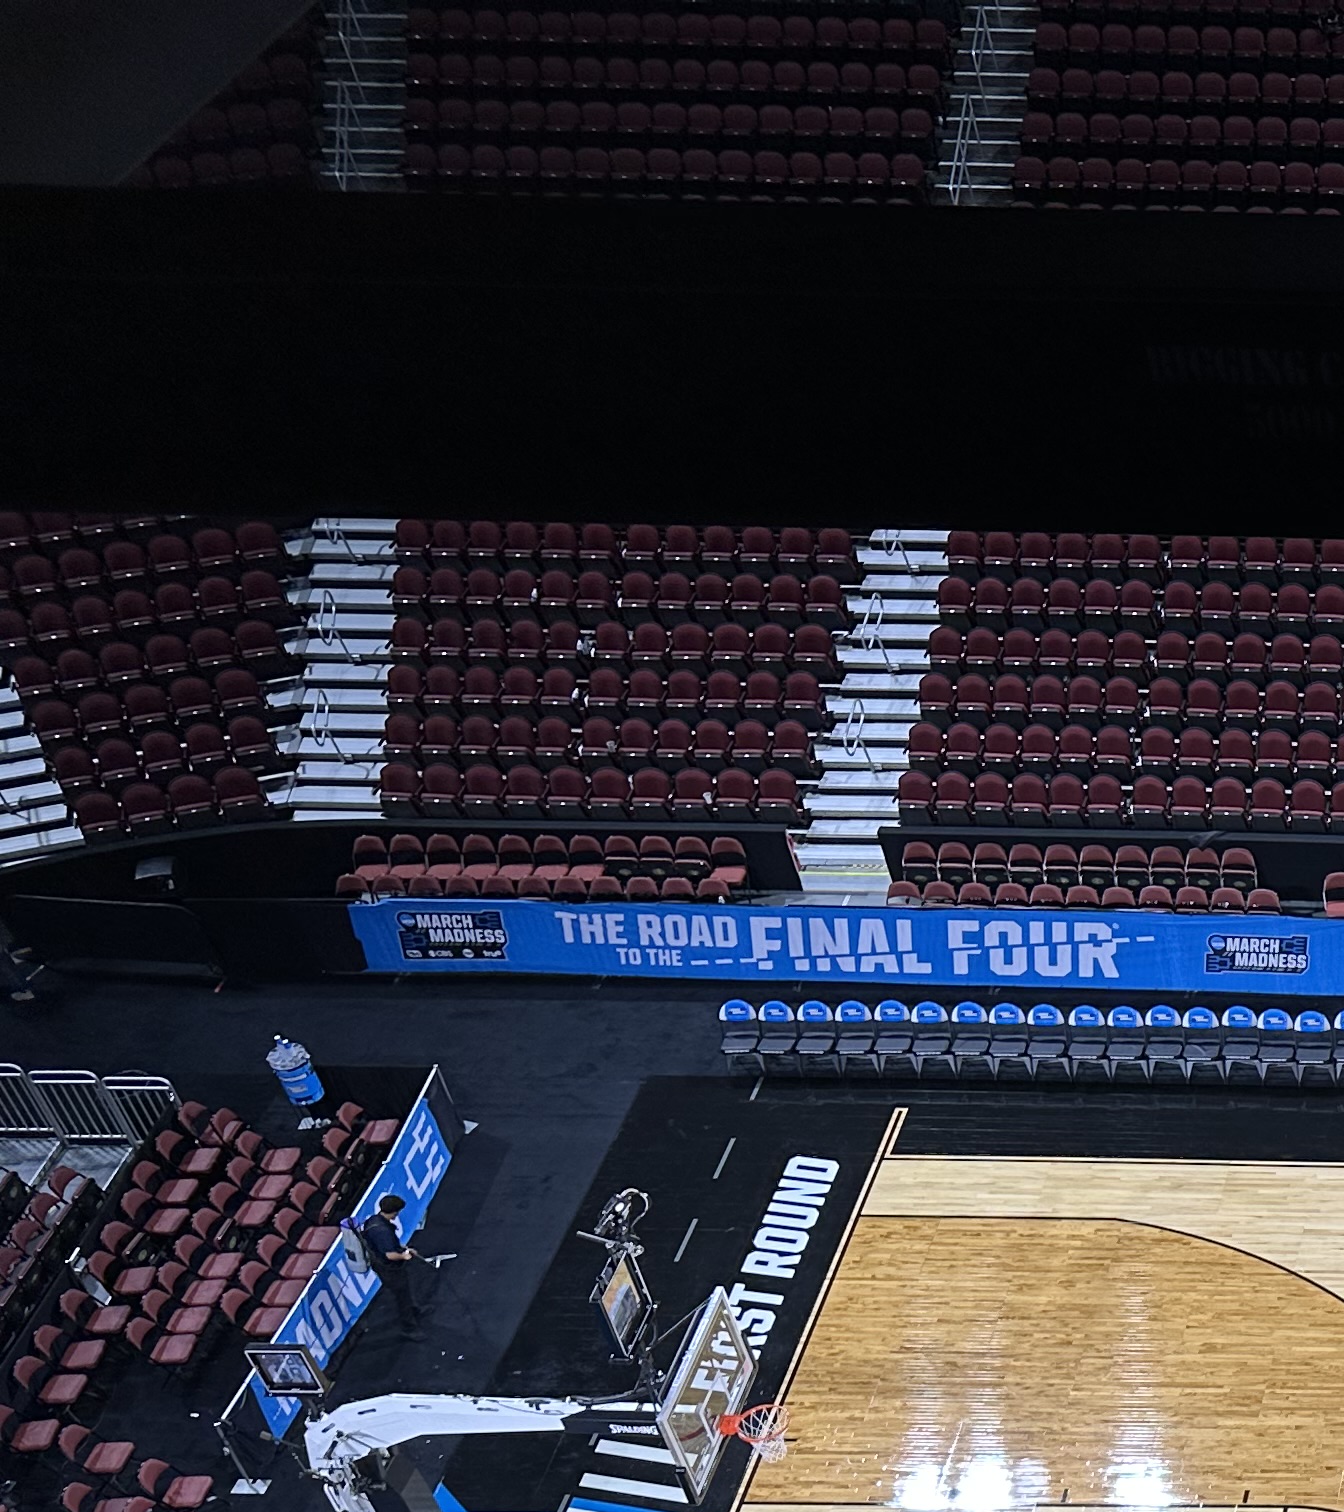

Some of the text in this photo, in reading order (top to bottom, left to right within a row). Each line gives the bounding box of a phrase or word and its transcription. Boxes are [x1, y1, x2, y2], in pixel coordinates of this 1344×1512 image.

[416, 914, 473, 928] MARCH
[429, 929, 505, 943] MADNESS
[554, 912, 738, 948] THE ROAD
[615, 916, 1120, 978] TO THE FINAL FOUR
[1226, 938, 1279, 953] MARCH
[1235, 953, 1307, 968] MADNESS
[741, 1155, 840, 1278] ROUND
[609, 1424, 659, 1435] SPALDING
